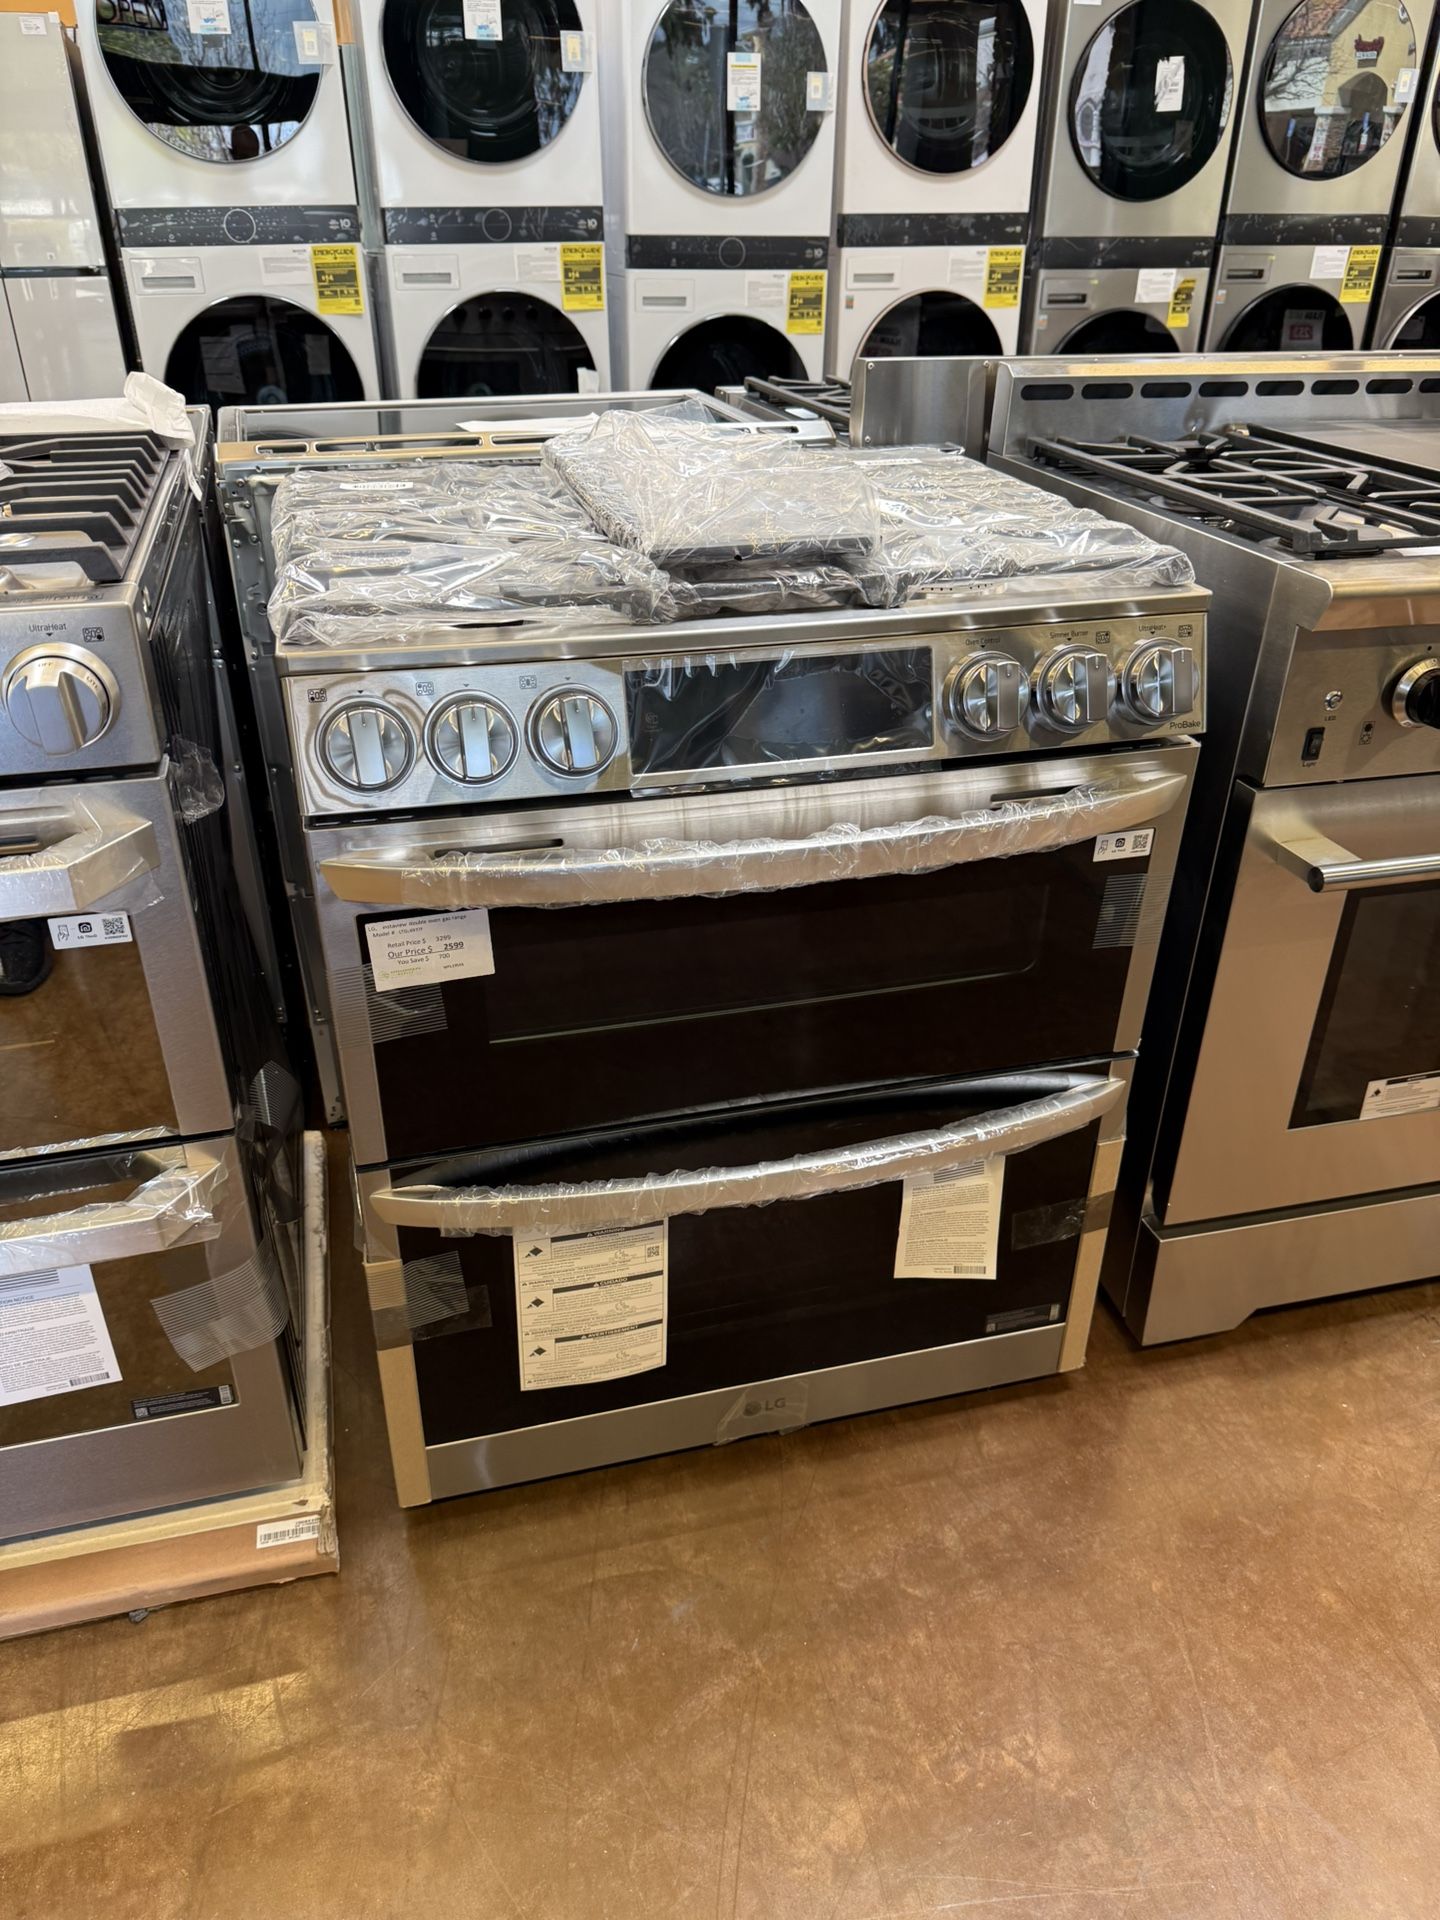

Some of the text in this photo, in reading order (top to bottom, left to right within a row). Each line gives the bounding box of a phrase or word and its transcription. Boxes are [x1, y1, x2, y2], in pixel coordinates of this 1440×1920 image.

[29, 623, 67, 632] UltraHeat
[1071, 629, 1089, 637] Burner
[965, 636, 1001, 646] Oven Control
[1170, 719, 1202, 730] ProBake
[372, 930, 390, 938] Model
[435, 934, 452, 943] 3299
[387, 941, 406, 949] Retail
[407, 939, 421, 947] Price
[443, 941, 464, 951] 2599
[388, 949, 403, 960] Our
[405, 947, 425, 956] Price
[439, 952, 451, 960] 700
[398, 957, 409, 966] You
[410, 956, 424, 964] Save
[765, 1397, 786, 1411] LG
